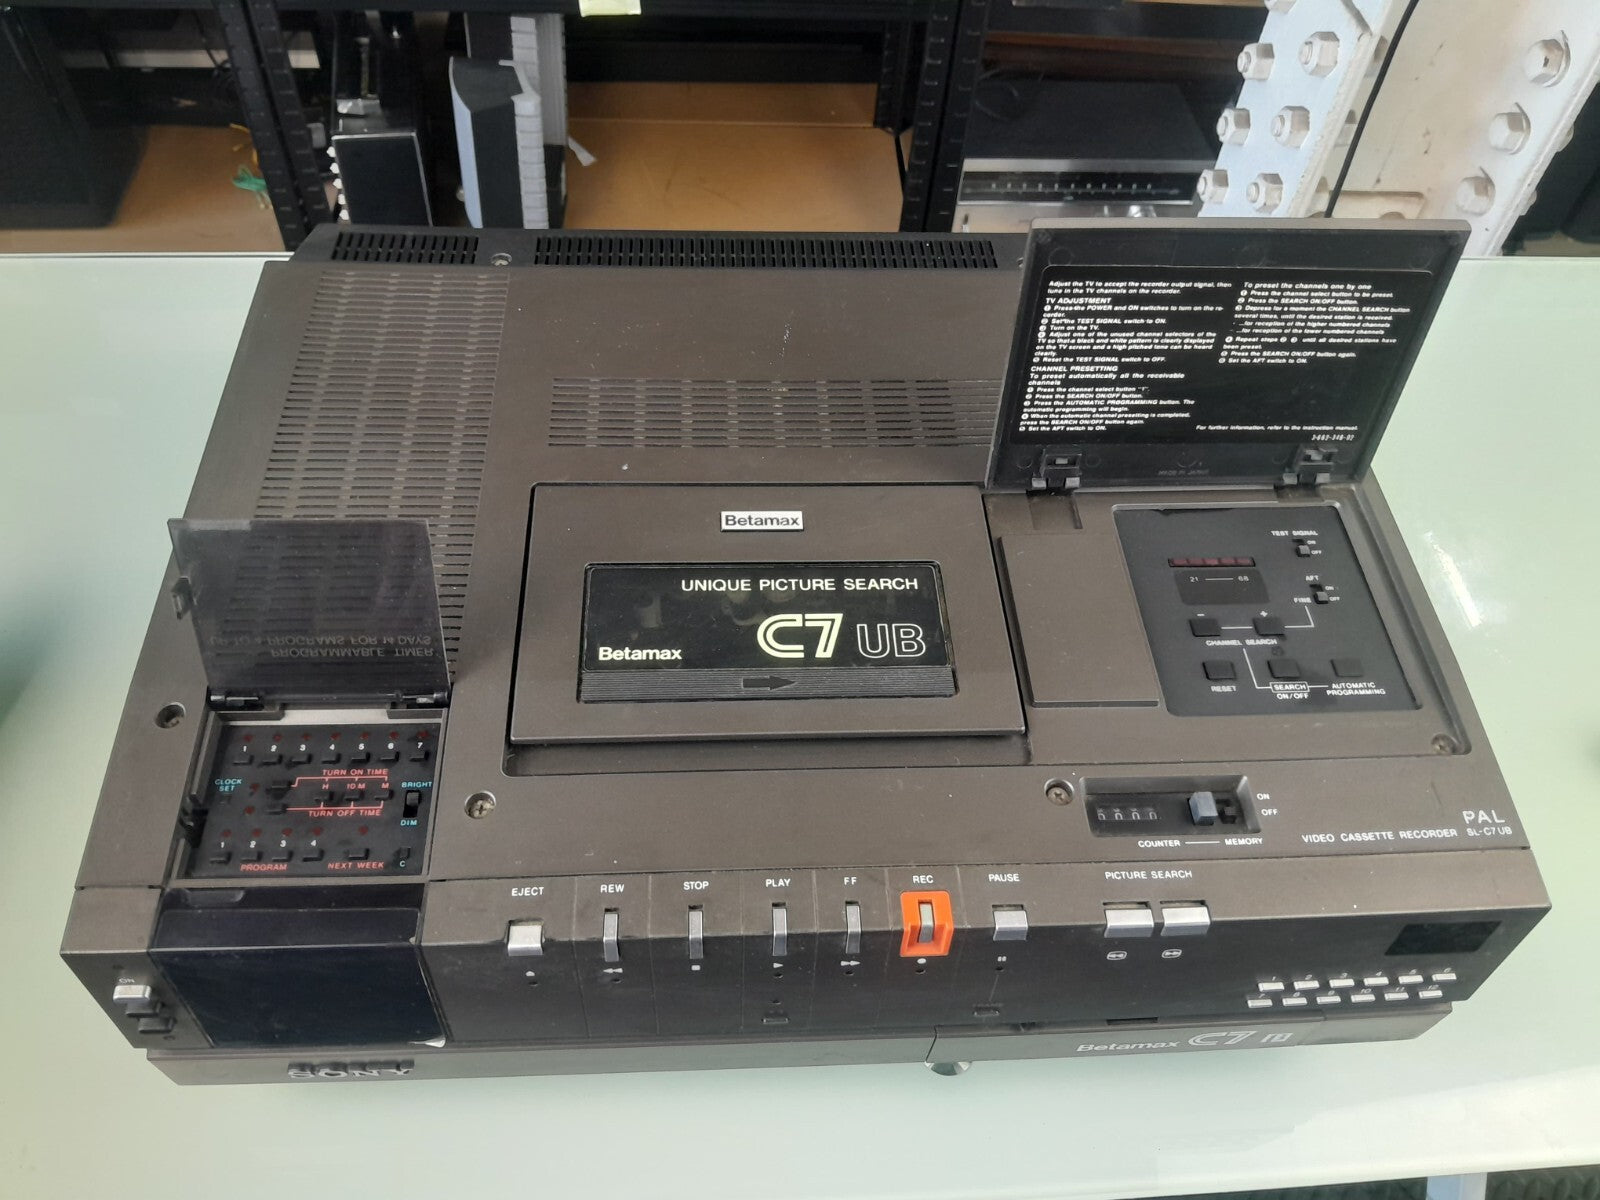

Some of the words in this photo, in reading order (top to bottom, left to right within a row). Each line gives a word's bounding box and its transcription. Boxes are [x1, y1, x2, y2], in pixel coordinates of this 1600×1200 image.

[725, 514, 800, 526] Betamax
[681, 579, 752, 592] UNIQUE
[759, 578, 836, 591] PICTURE
[843, 578, 918, 590] SEARCH
[757, 613, 844, 658] C7
[857, 623, 926, 659] UB
[598, 647, 682, 661] Betamax
[1462, 810, 1505, 825] PAL
[1302, 834, 1335, 843] VIDEO
[1340, 831, 1395, 842] CASSETTE
[1400, 829, 1458, 839] RECORDER
[912, 875, 934, 884] REC
[988, 873, 1020, 883] PAUSE
[1105, 871, 1147, 880] PICTURE
[1151, 870, 1192, 879] SEARCH
[683, 881, 709, 890] STOP
[765, 878, 791, 888] PLAY
[844, 877, 857, 885] FF
[512, 886, 544, 897] EJECT
[600, 884, 624, 893] REW
[1076, 1040, 1181, 1052] Betamax
[1188, 1030, 1258, 1046] C7
[288, 1060, 414, 1079] SONY
